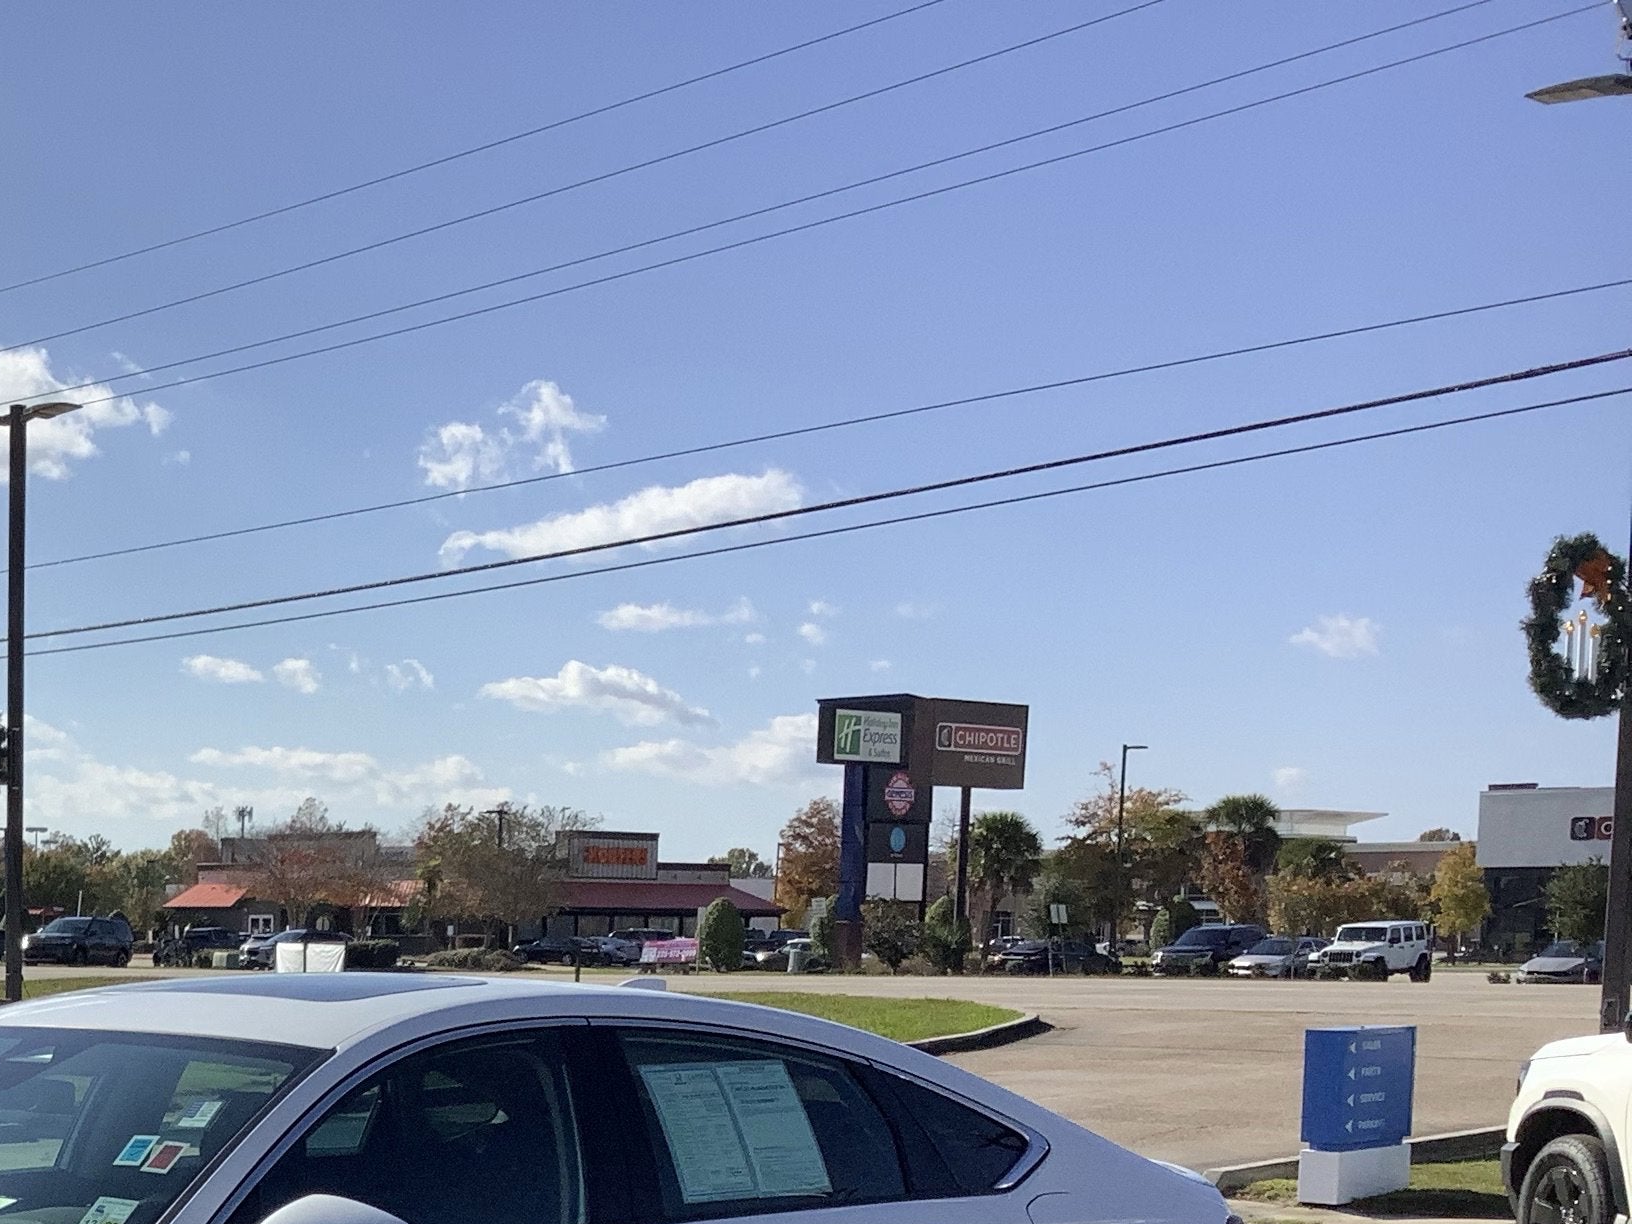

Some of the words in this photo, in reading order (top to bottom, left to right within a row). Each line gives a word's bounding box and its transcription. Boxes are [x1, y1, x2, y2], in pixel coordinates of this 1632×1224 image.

[863, 728, 898, 745] Express
[956, 731, 1018, 748] CHIPOTLE
[964, 755, 995, 763] MEXICAN
